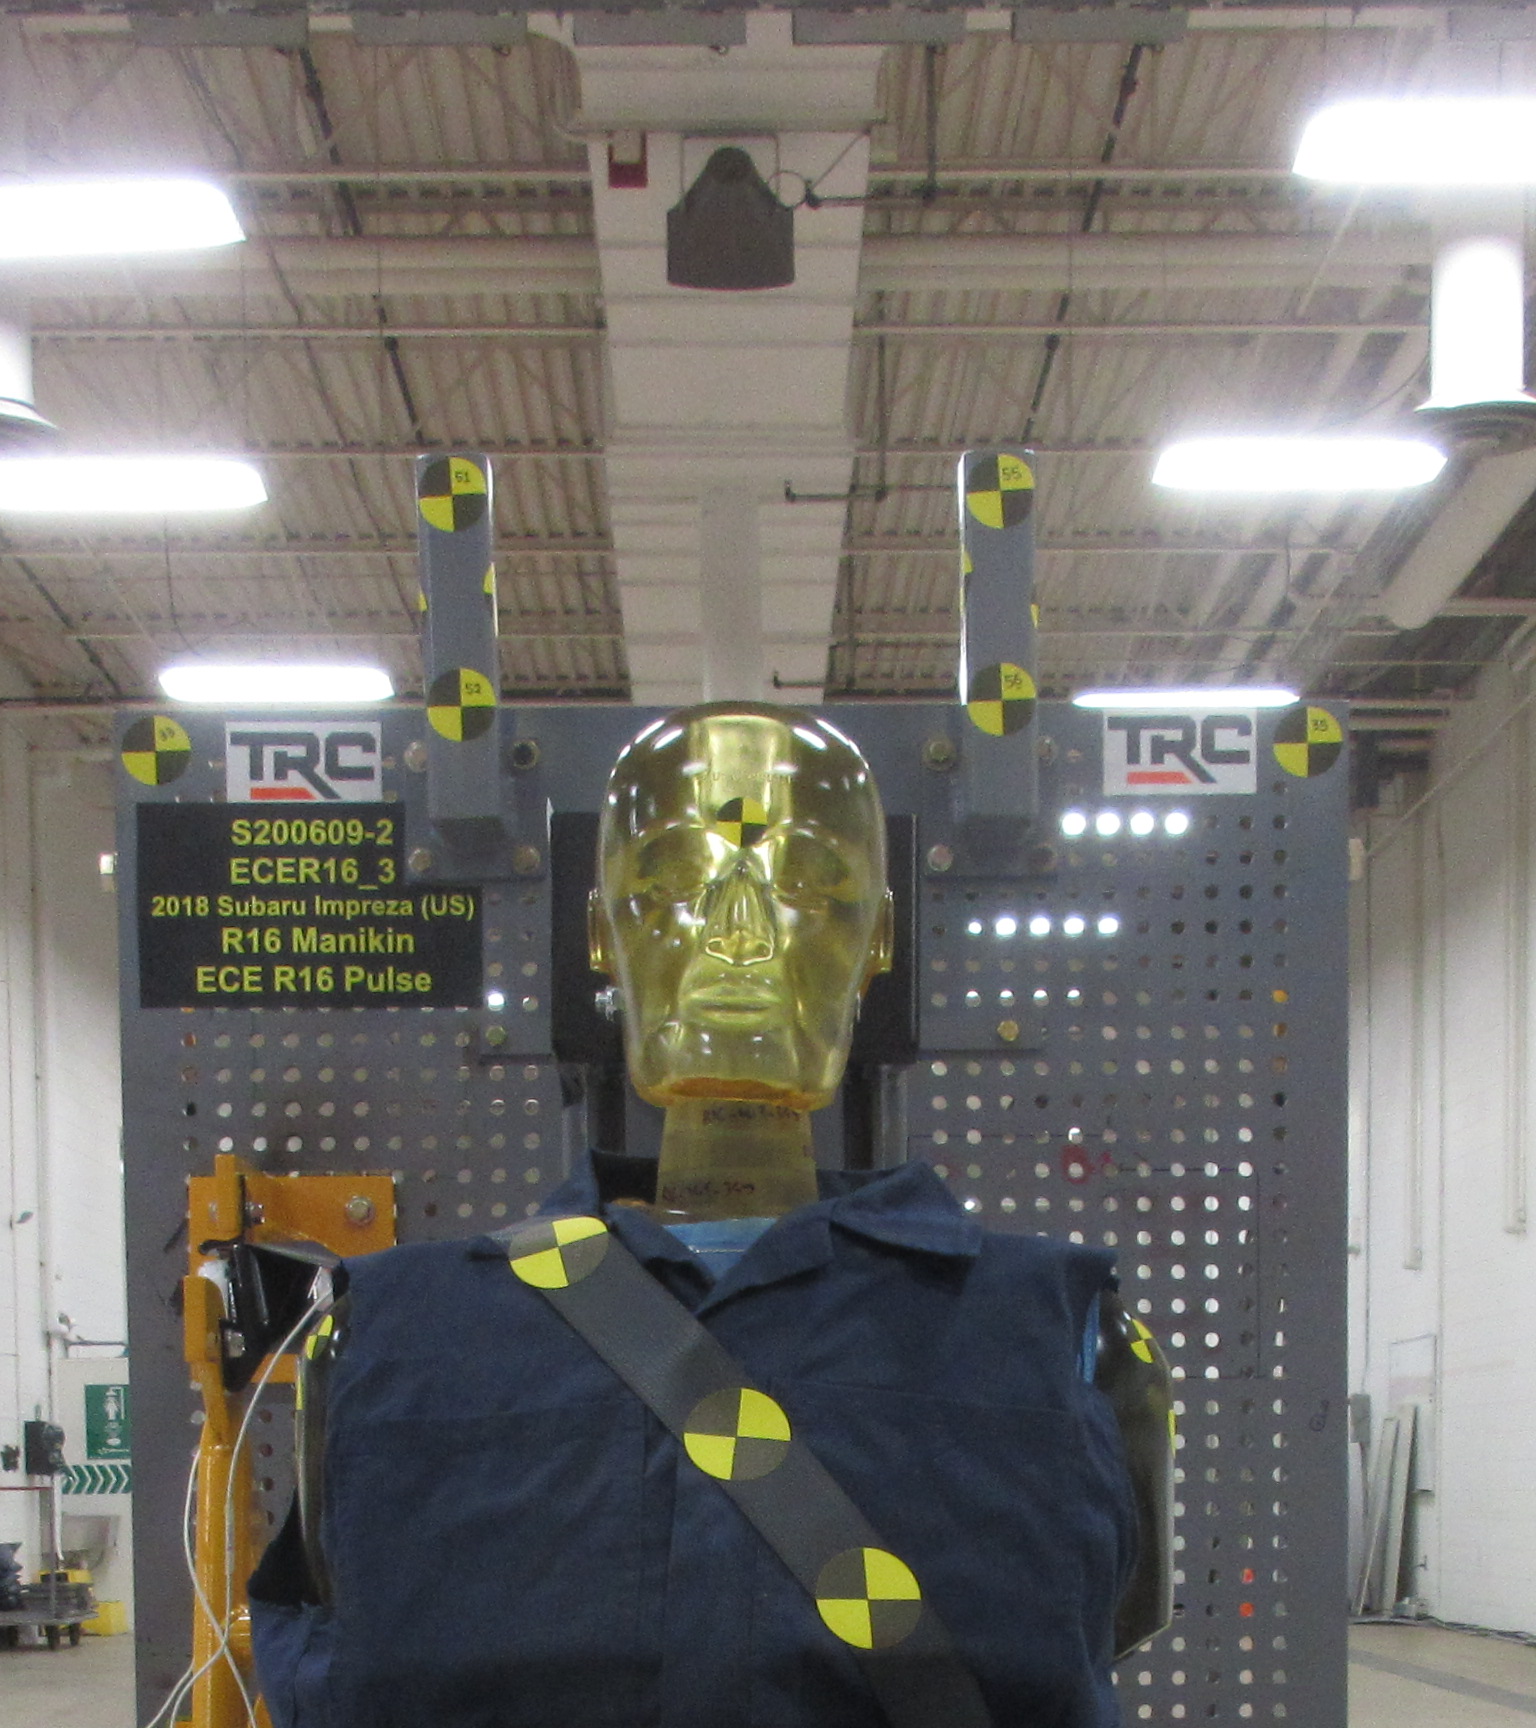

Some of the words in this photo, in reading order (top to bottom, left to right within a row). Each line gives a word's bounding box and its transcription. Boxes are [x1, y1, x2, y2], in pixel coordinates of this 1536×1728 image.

[1107, 714, 1253, 784] TRC
[230, 731, 376, 799] TRC
[230, 818, 395, 847] S200609-2
[229, 857, 396, 890] ECER16_3
[151, 895, 210, 918] 2018
[217, 895, 307, 918] Subaru
[315, 895, 414, 921] Impreza
[421, 895, 475, 921] (US)
[221, 927, 282, 954] R16
[292, 926, 416, 954] Manikin
[195, 966, 263, 993] ECE
[273, 966, 334, 993] R16
[344, 965, 433, 993] Pulse
